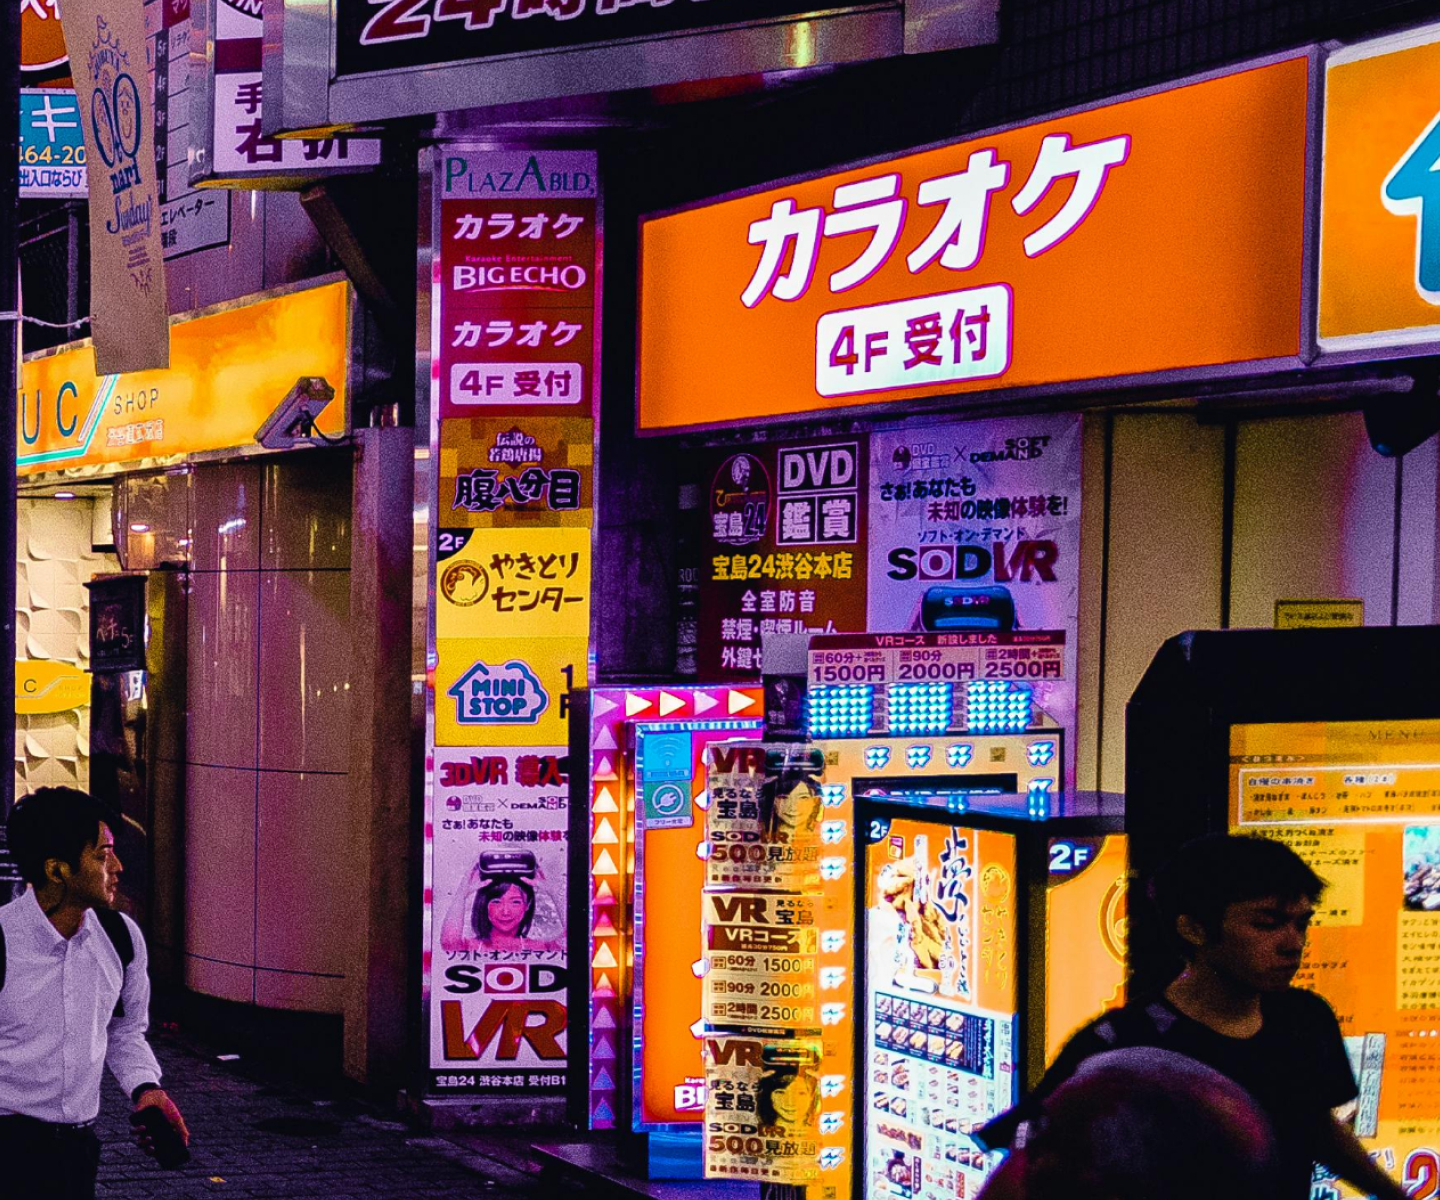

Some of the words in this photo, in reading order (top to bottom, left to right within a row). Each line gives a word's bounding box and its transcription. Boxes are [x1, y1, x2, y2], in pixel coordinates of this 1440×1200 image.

[445, 156, 547, 193] PLAZA
[453, 213, 584, 240] カラオケ
[740, 132, 1132, 308] カラオケ
[465, 255, 503, 263] Karaoke
[505, 255, 573, 263] Entertainment
[453, 265, 505, 291] BIG
[510, 265, 586, 289] ECHO
[451, 321, 582, 347] カラオケ
[829, 324, 890, 376] 4F
[903, 304, 992, 372] 受付
[459, 370, 504, 396] 4F
[513, 369, 572, 397] 受付
[114, 387, 159, 415] SHOP
[496, 432, 536, 446] 伝説の
[783, 449, 854, 489] DVD
[451, 467, 581, 512] 腹八分目
[782, 499, 852, 541] 鑑賞
[439, 534, 465, 551] 2F
[490, 551, 579, 580] やきとり
[712, 552, 854, 581] 宝島24渋谷本店
[491, 585, 585, 613] センター
[741, 589, 816, 613] 全室防音
[875, 635, 926, 646] VRコース
[937, 634, 998, 645] 新設しました
[913, 650, 943, 662] 90分
[813, 664, 886, 682] 1500円
[898, 662, 976, 680] 2000円
[985, 660, 1062, 679] 2500円
[471, 678, 526, 695] MINI
[469, 696, 527, 716] STOP
[439, 756, 509, 787] 3DVR
[711, 747, 766, 773] VR
[870, 820, 888, 838] 2F
[1048, 843, 1090, 871] 2F
[711, 896, 770, 925] VR
[727, 955, 756, 968] 60分
[443, 964, 568, 994] SOD
[727, 982, 756, 995] 90分
[441, 999, 568, 1061] VR
[707, 1039, 764, 1068] VR
